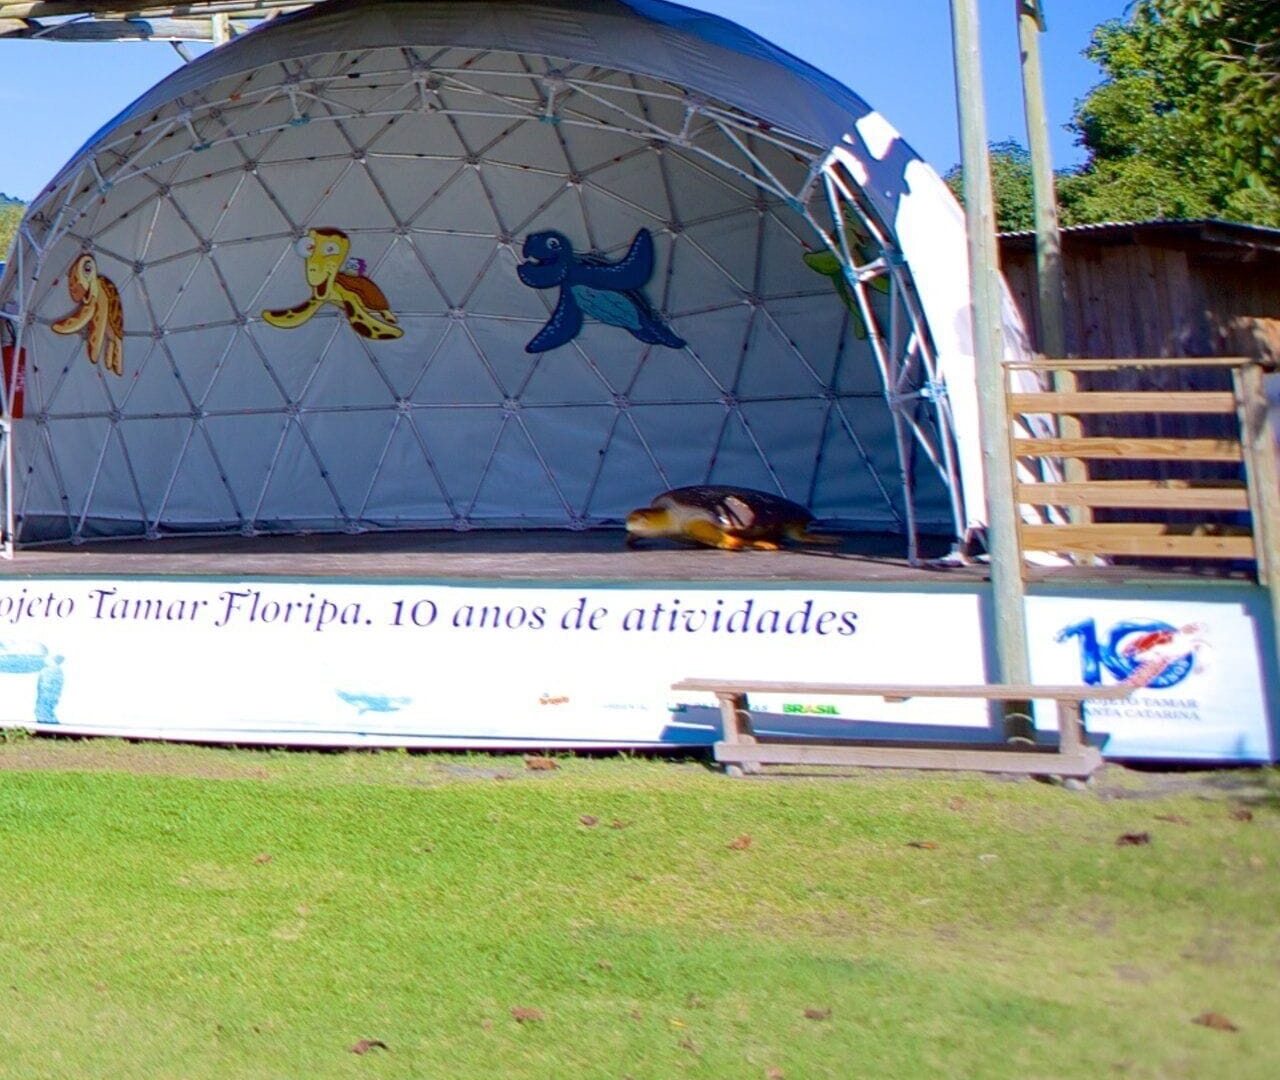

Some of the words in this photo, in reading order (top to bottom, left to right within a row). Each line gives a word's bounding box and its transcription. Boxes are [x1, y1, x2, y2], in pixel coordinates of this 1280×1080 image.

[87, 588, 209, 622] Tamar
[214, 589, 373, 633] Floripa.
[390, 598, 439, 628] 10
[451, 603, 547, 631] anos
[560, 596, 609, 633] de
[621, 597, 860, 637] atividades
[782, 703, 841, 716] BRASIL
[1142, 697, 1200, 709] TAMAR
[1124, 708, 1202, 722] CATARINA
